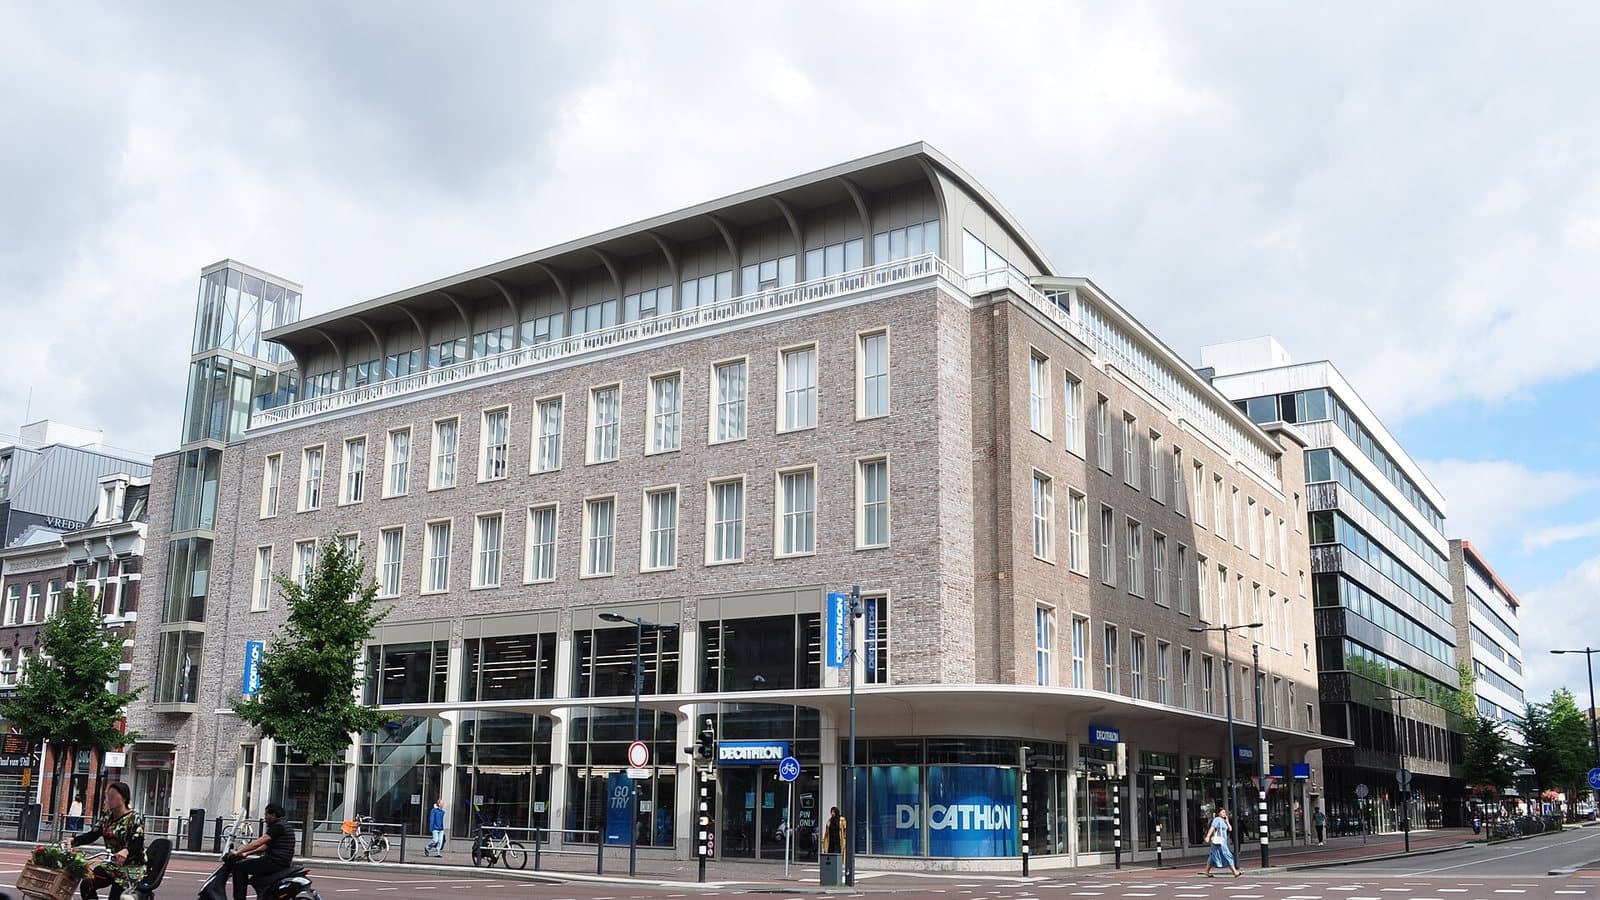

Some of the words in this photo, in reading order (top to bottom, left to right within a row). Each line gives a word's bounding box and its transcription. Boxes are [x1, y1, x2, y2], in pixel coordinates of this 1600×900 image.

[719, 746, 783, 760] DECATHLON
[614, 785, 629, 797] GO
[610, 797, 629, 809] TRY
[799, 819, 815, 827] ONLY
